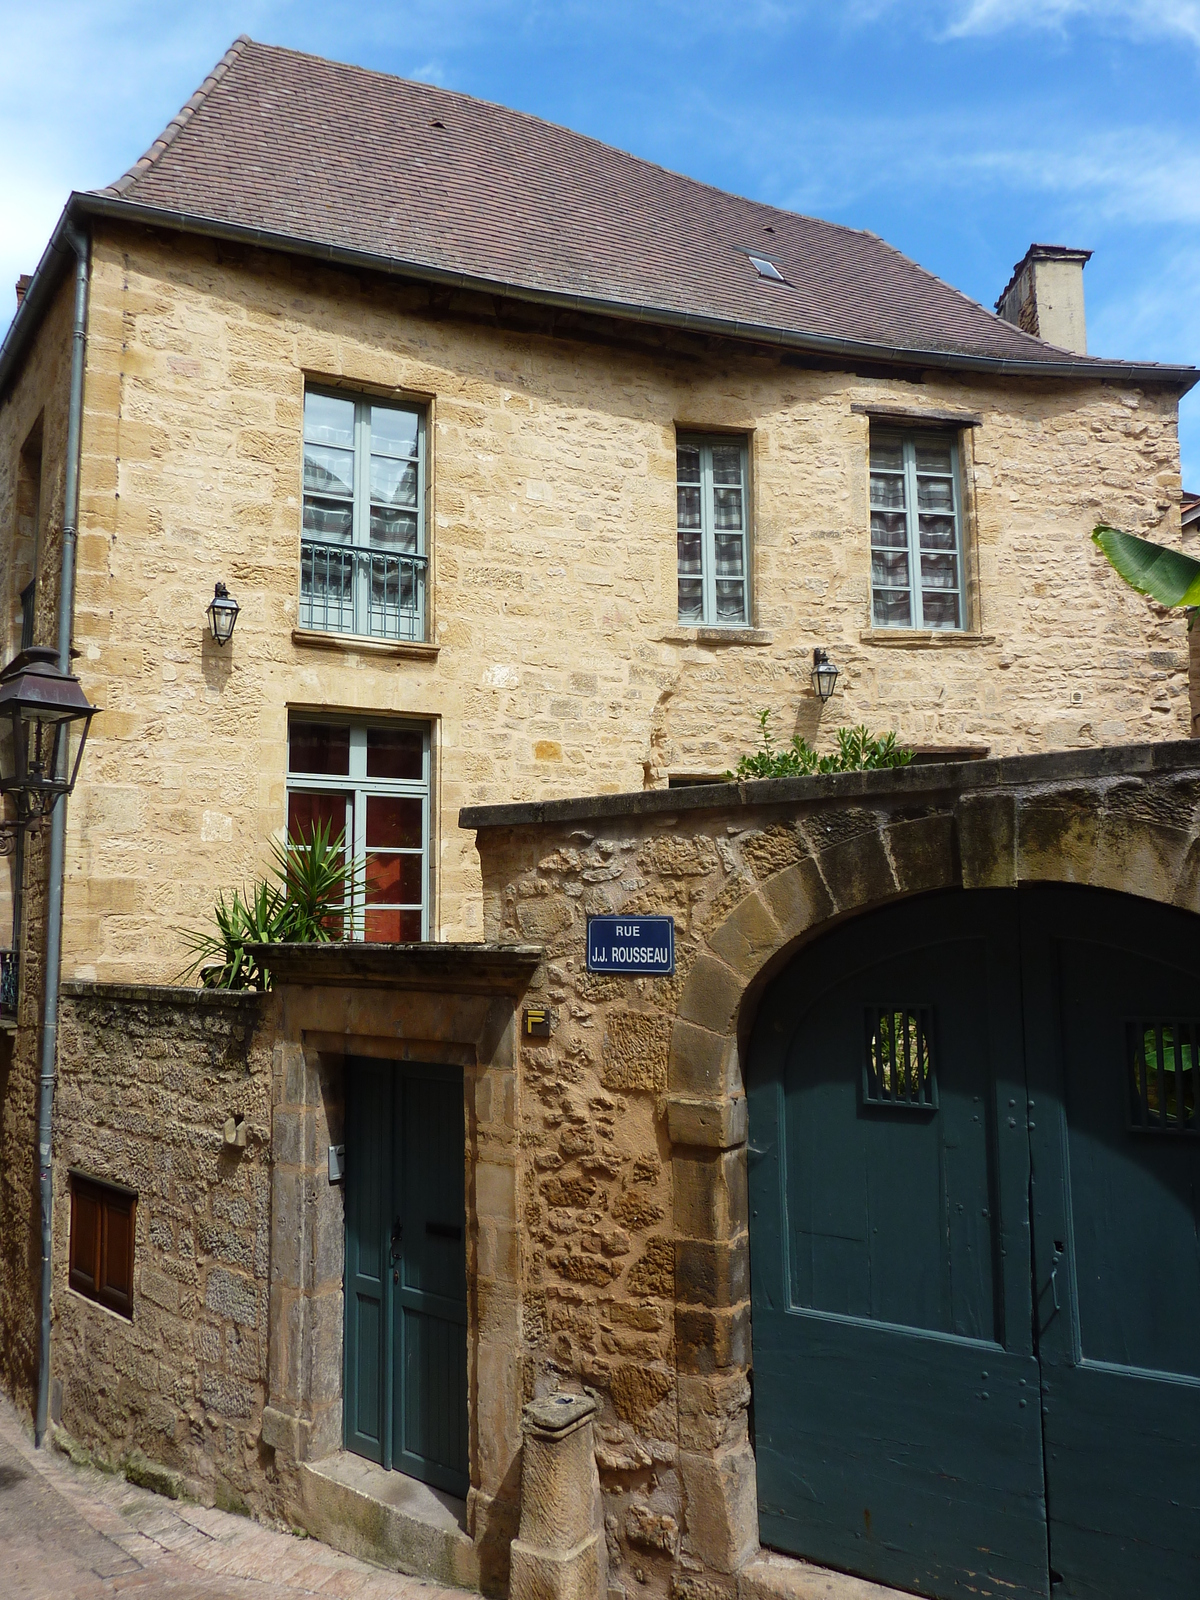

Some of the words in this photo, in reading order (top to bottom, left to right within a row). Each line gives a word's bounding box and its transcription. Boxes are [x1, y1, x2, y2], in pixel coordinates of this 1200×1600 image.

[616, 925, 640, 937] RUE
[592, 946, 608, 963] J.J.
[611, 946, 668, 964] ROUSSEAU
